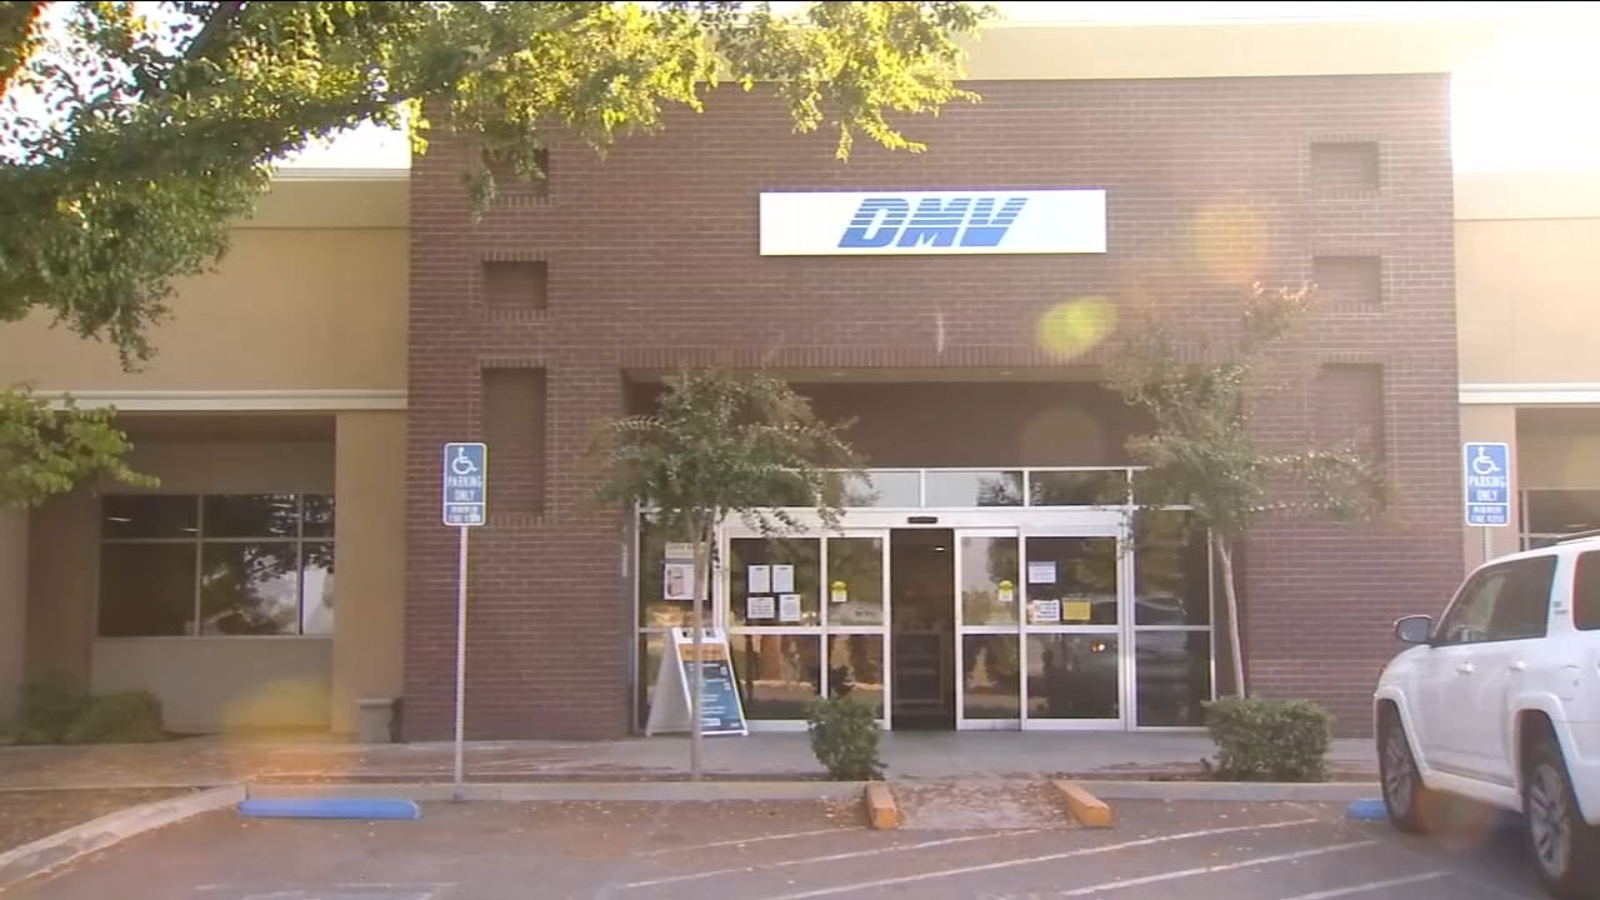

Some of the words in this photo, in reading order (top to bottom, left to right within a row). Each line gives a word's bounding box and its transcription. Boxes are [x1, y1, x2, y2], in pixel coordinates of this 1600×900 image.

[837, 198, 1028, 248] DMV
[448, 475, 483, 488] PARKING
[1468, 475, 1506, 488] PARKING
[454, 489, 475, 502] ONLY
[1476, 489, 1498, 502] ONLY
